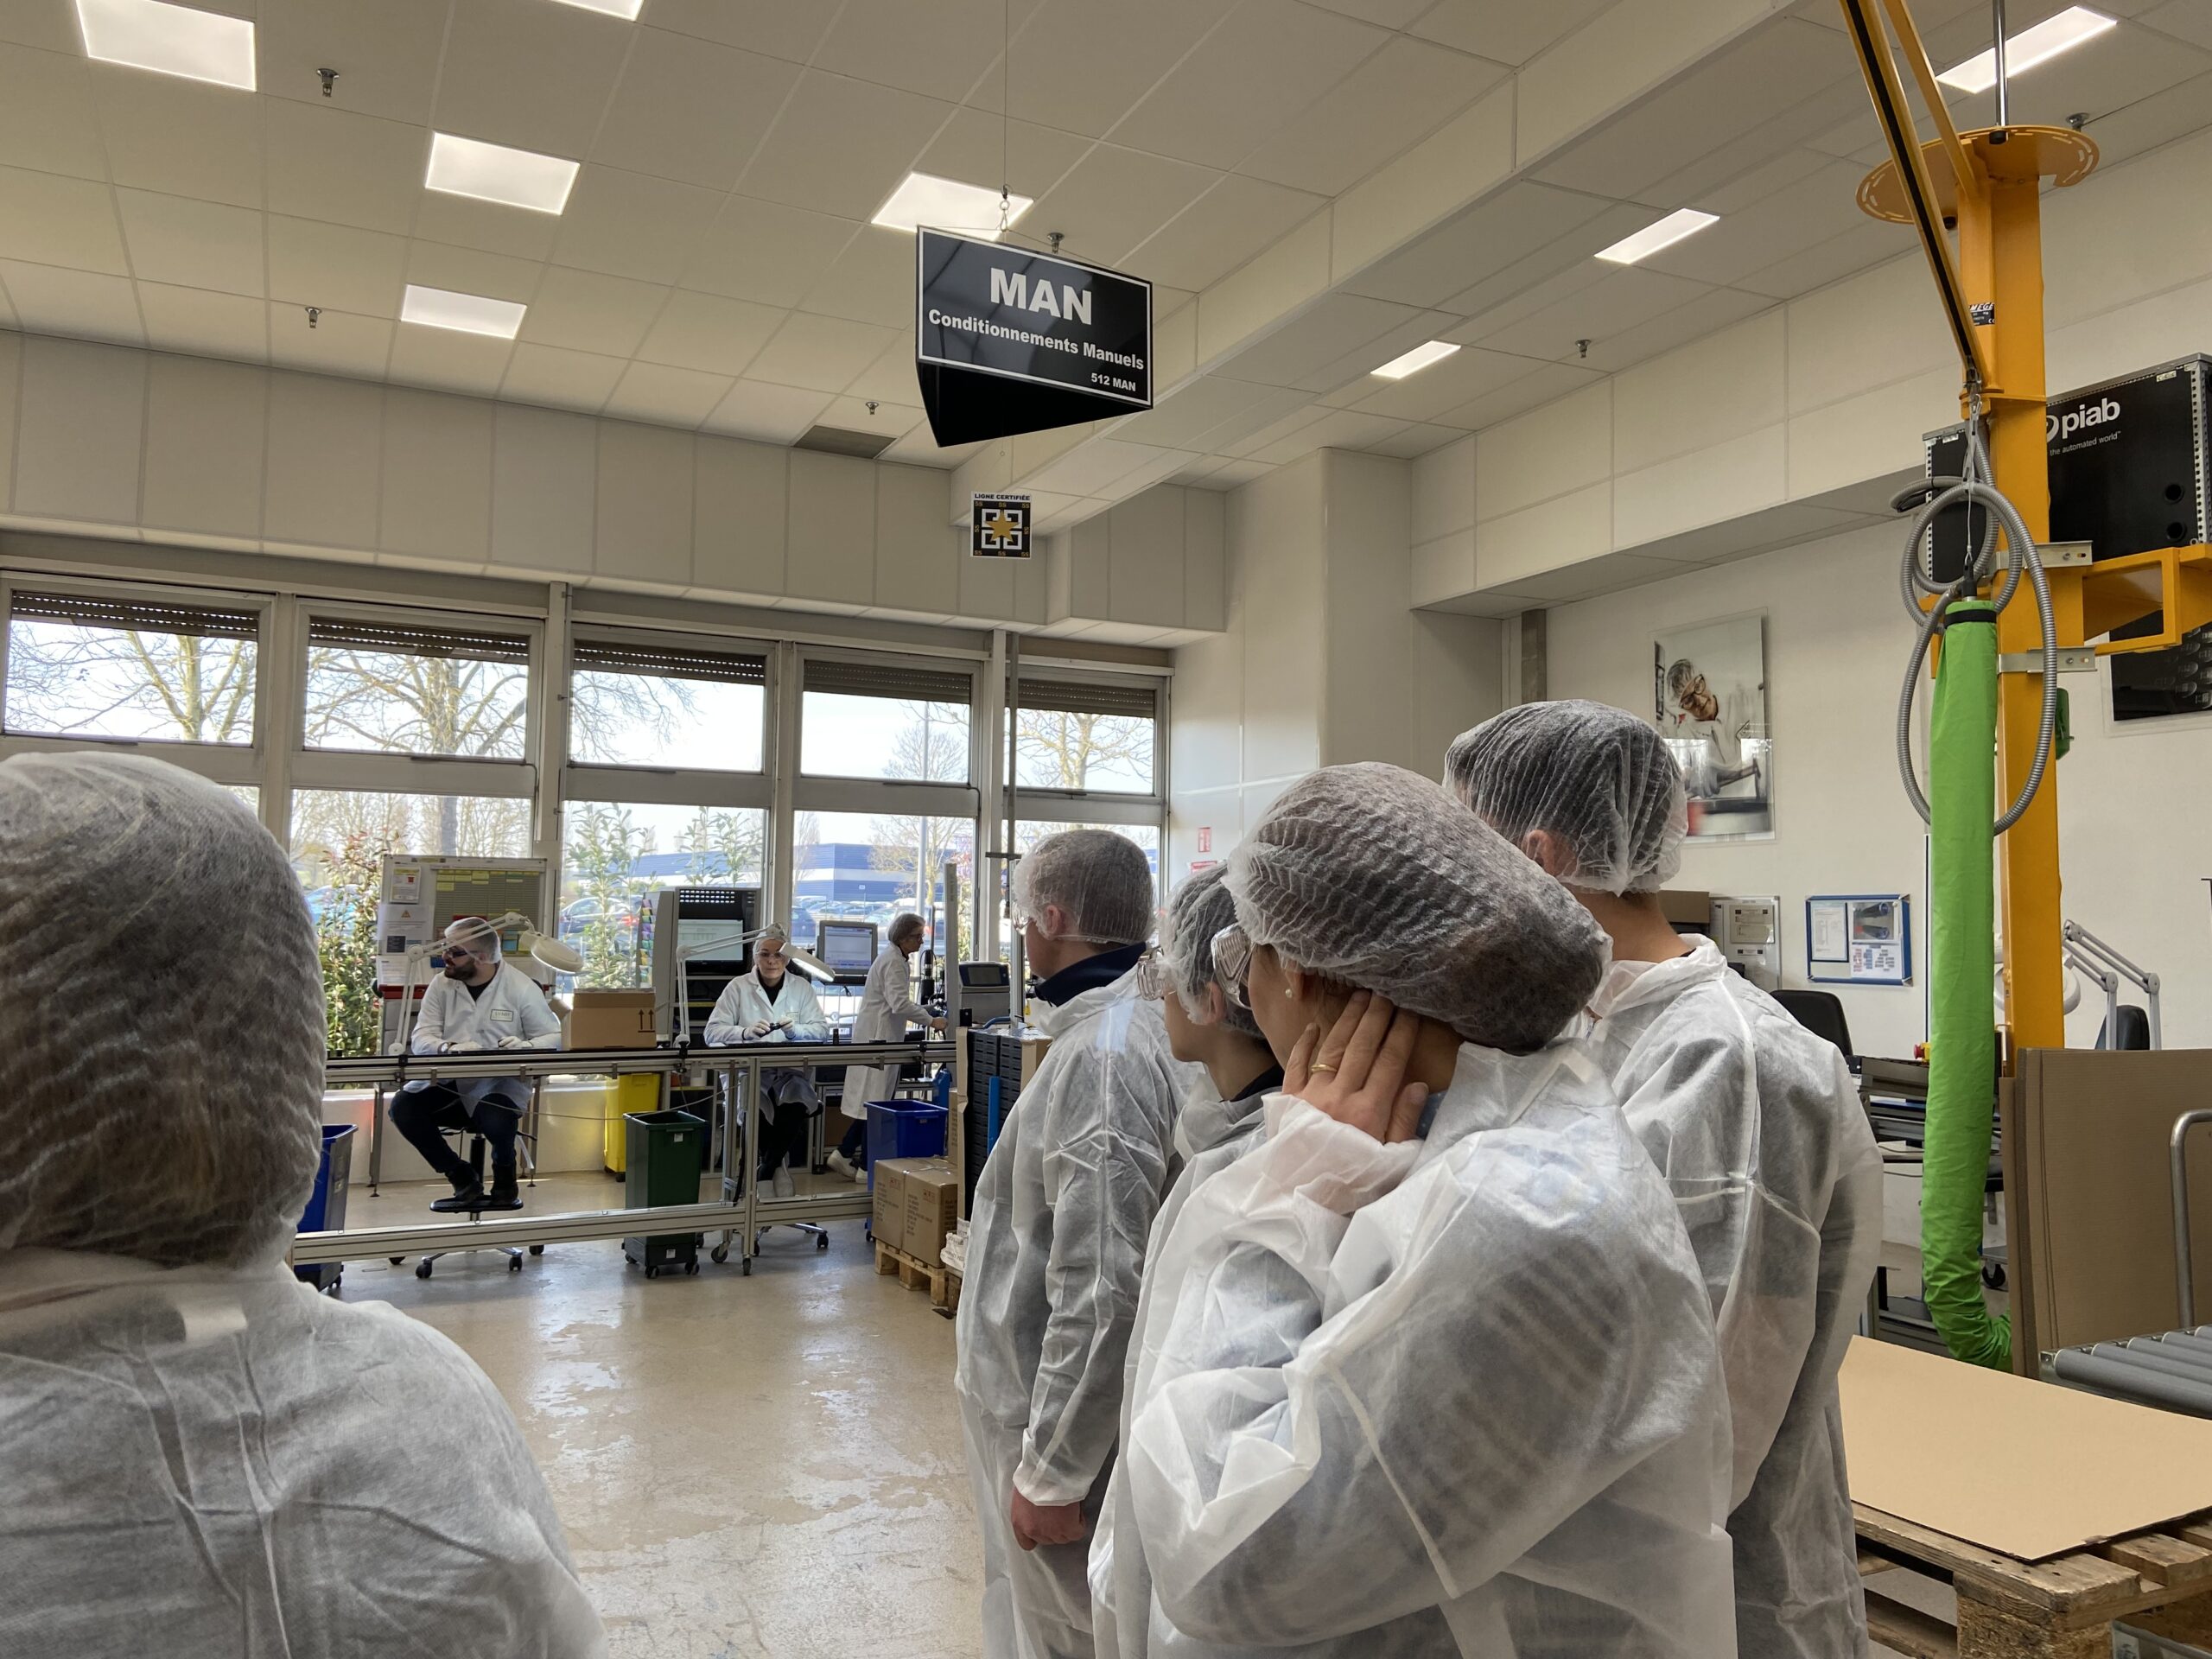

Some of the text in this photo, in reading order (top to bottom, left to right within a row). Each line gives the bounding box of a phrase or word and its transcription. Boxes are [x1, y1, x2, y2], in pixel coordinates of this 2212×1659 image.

[991, 267, 1092, 326] MAN
[928, 309, 1145, 370] Conditionnements Manuels
[1091, 372, 1136, 391] 512 MAN
[2062, 397, 2120, 439] piab
[2062, 437, 2097, 454] automated
